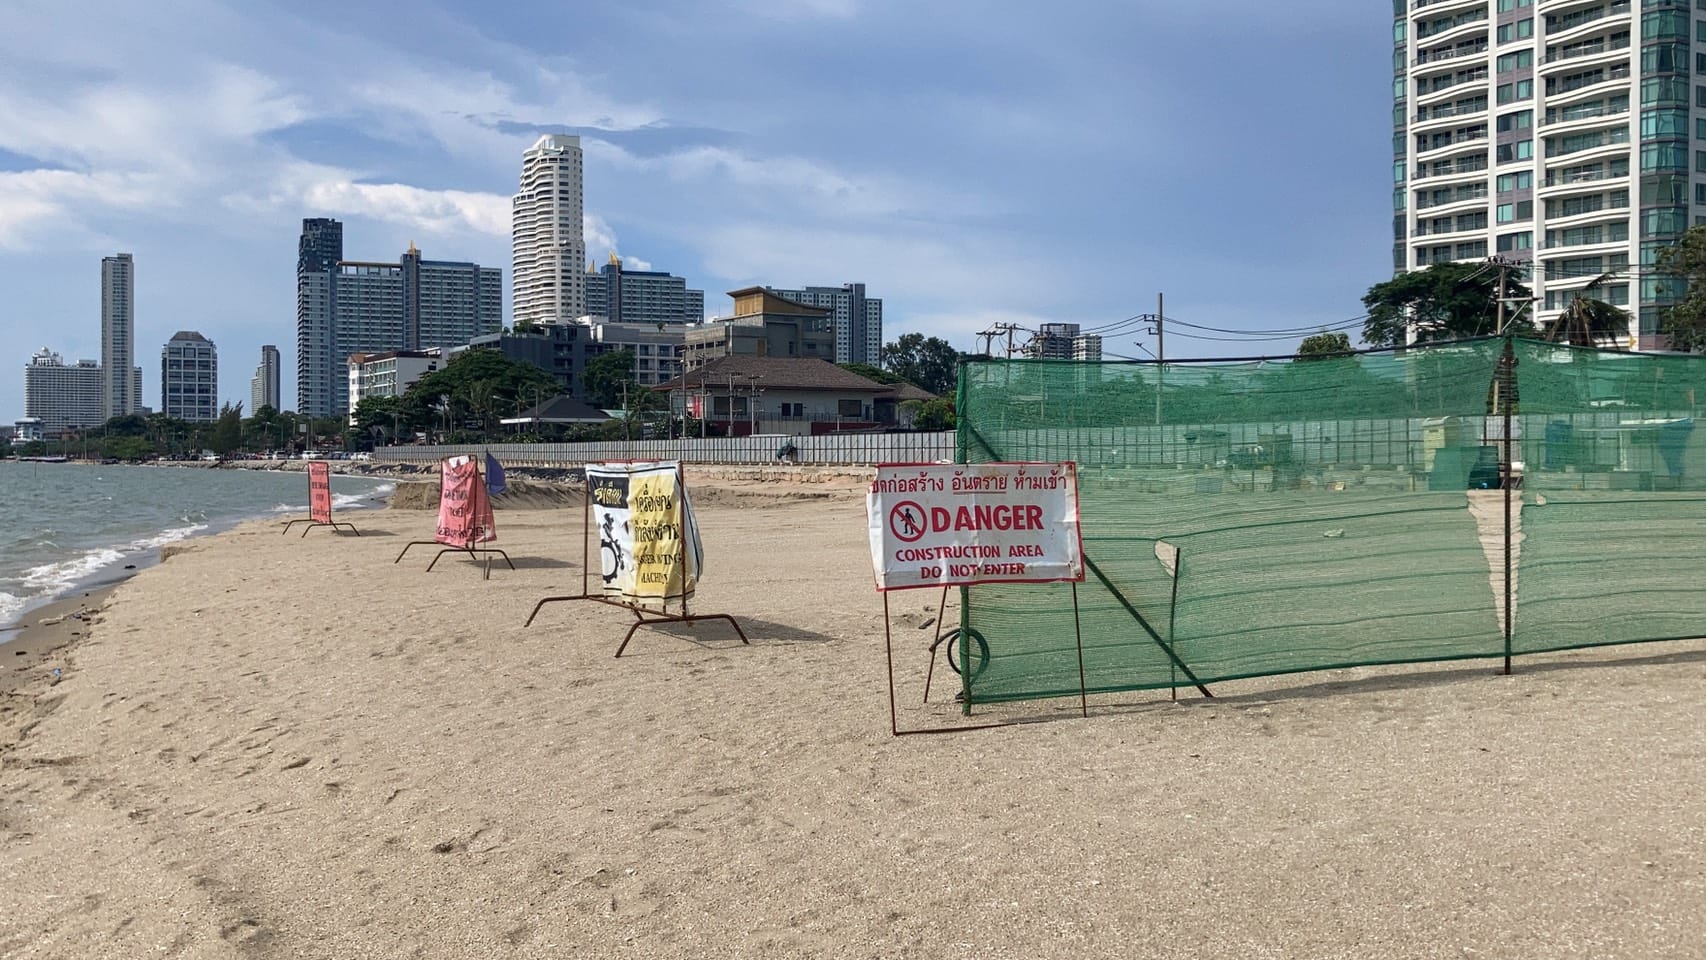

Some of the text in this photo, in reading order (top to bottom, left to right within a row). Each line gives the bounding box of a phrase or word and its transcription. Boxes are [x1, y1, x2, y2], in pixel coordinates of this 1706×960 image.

[951, 470, 1008, 491] อันตราย
[1013, 469, 1067, 490] ห้ามเข้า
[931, 505, 1044, 533] DANGER
[895, 544, 1044, 562] CONSTRUCTION AREA
[920, 562, 1025, 579] DO NOT ENTER
